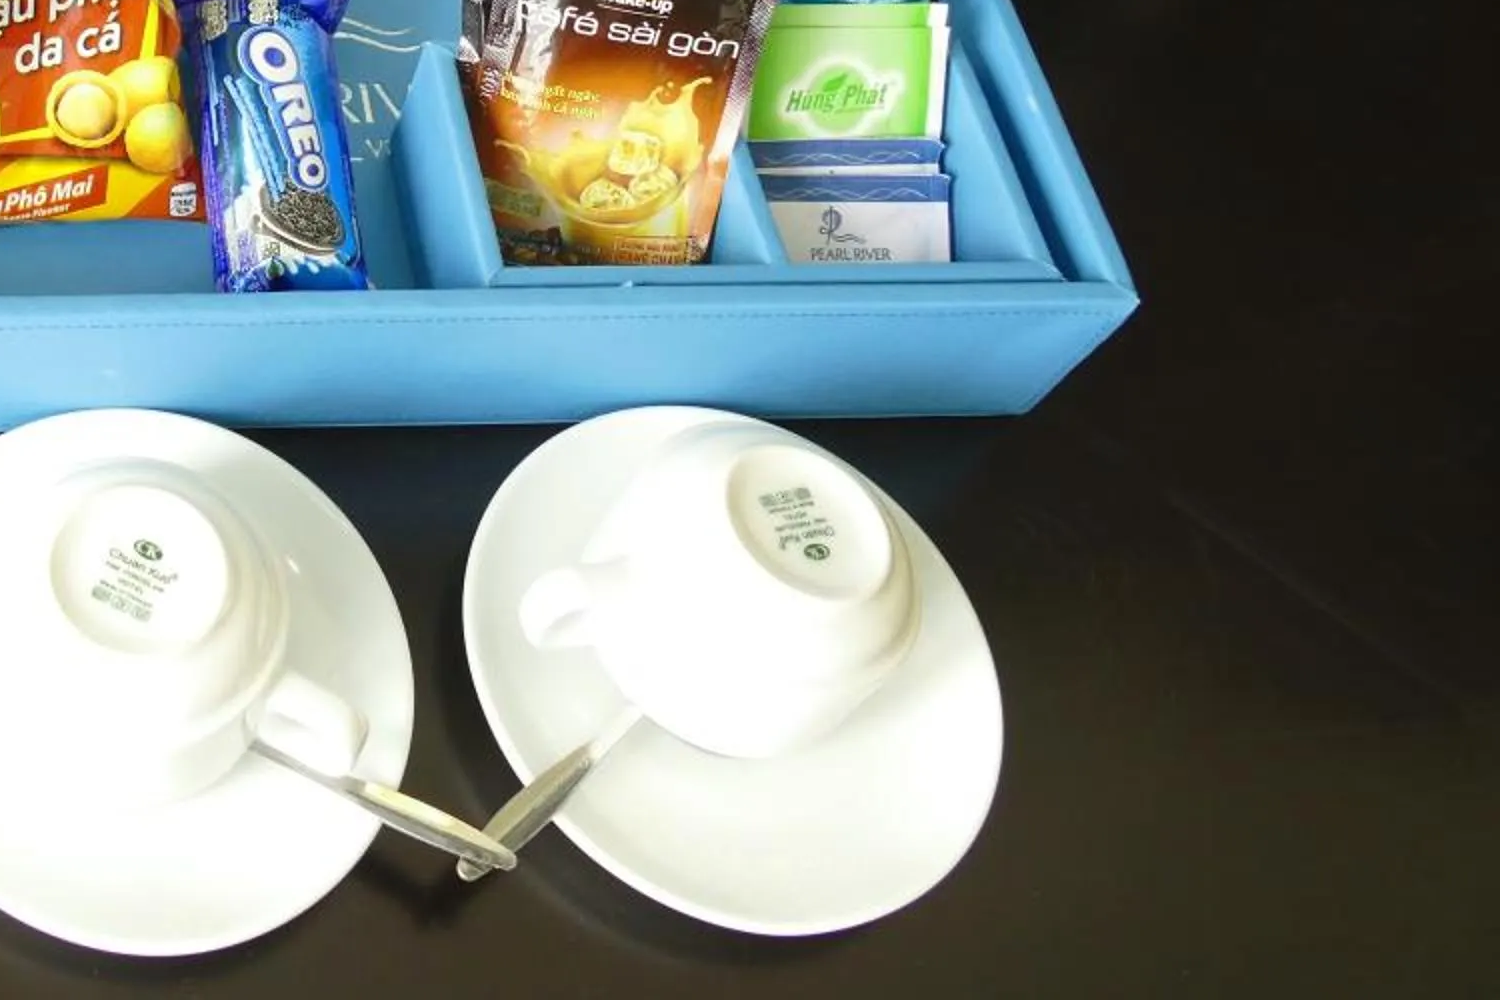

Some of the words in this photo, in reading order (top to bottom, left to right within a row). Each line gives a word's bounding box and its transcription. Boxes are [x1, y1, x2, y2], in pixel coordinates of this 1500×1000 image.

[14, 31, 64, 74] da
[75, 10, 122, 59] cá
[607, 22, 665, 47] sài
[667, 31, 740, 58] gòn
[249, 30, 327, 187] OREO
[3, 186, 48, 214] Phô
[50, 173, 95, 202] Mai
[810, 247, 852, 261] PEARL
[853, 247, 893, 261] RIVER
